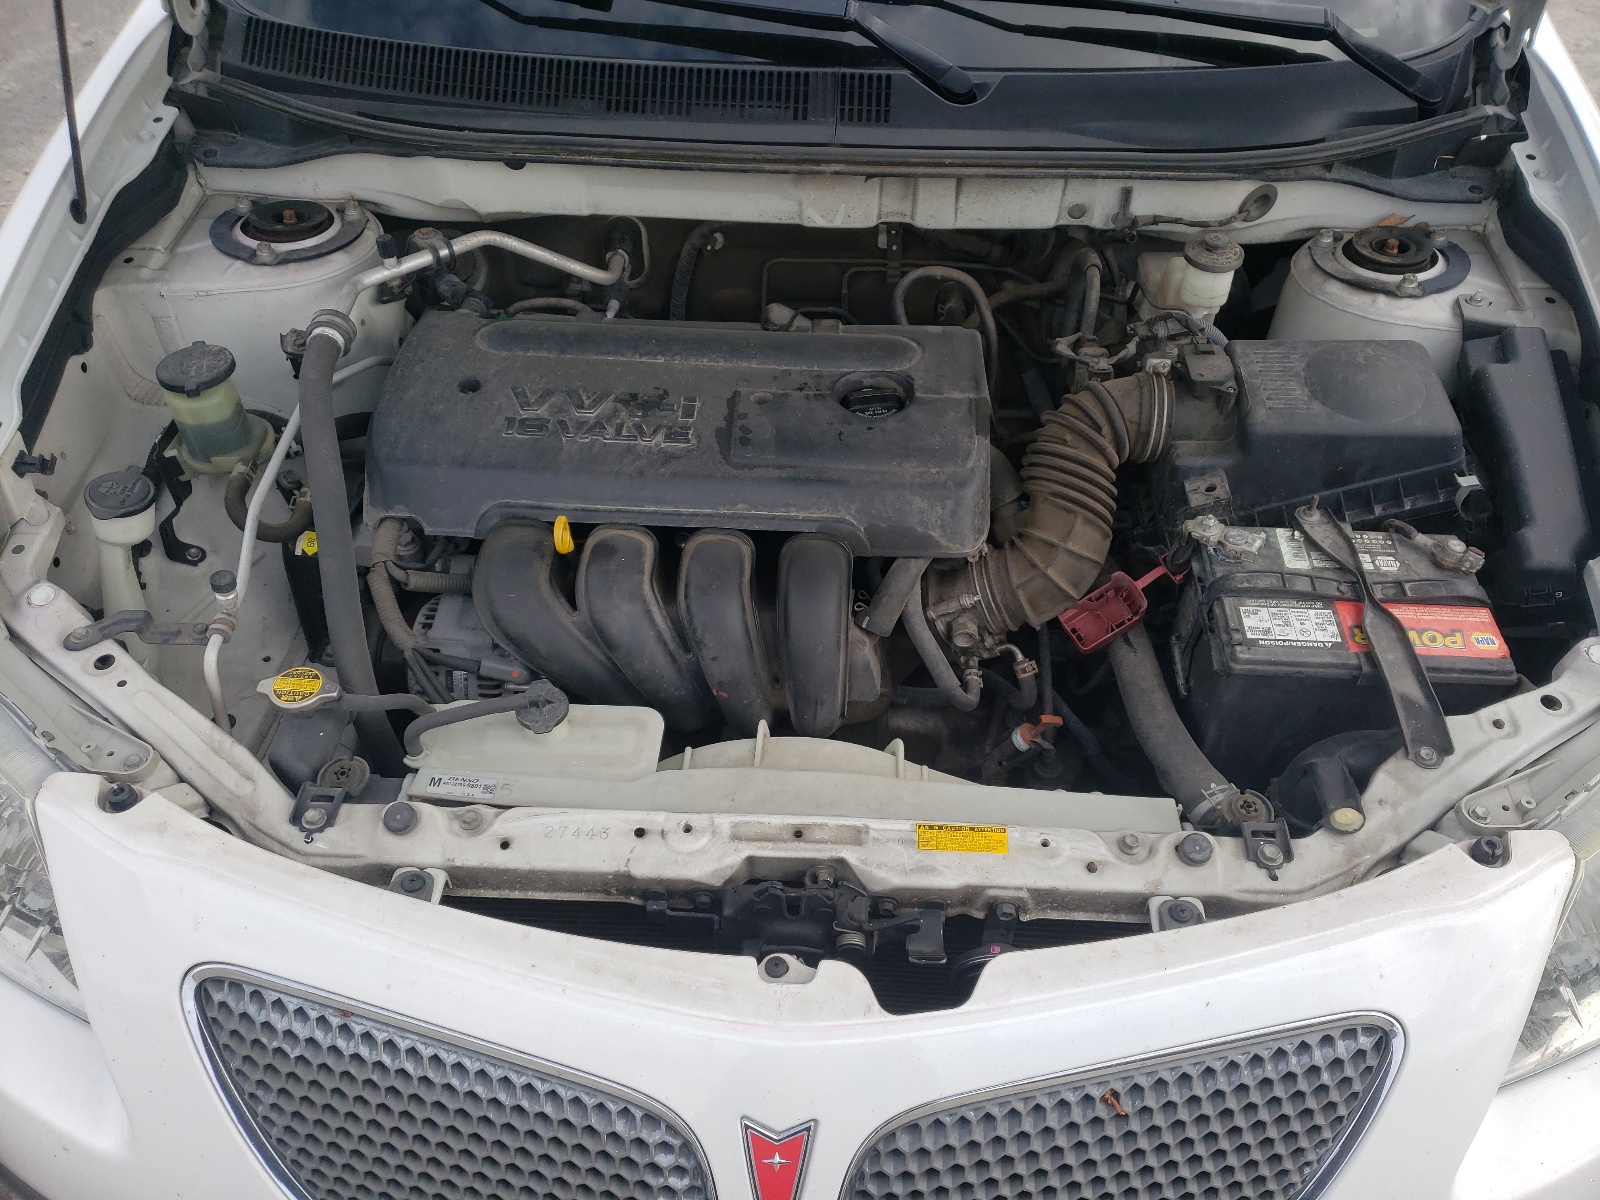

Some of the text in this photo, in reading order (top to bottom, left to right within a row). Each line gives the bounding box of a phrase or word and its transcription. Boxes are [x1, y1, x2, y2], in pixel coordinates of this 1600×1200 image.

[502, 416, 694, 447] 16 VALVE
[1473, 636, 1498, 646] NAPA
[428, 776, 480, 788] M DENSO
[544, 825, 610, 839] 27443
